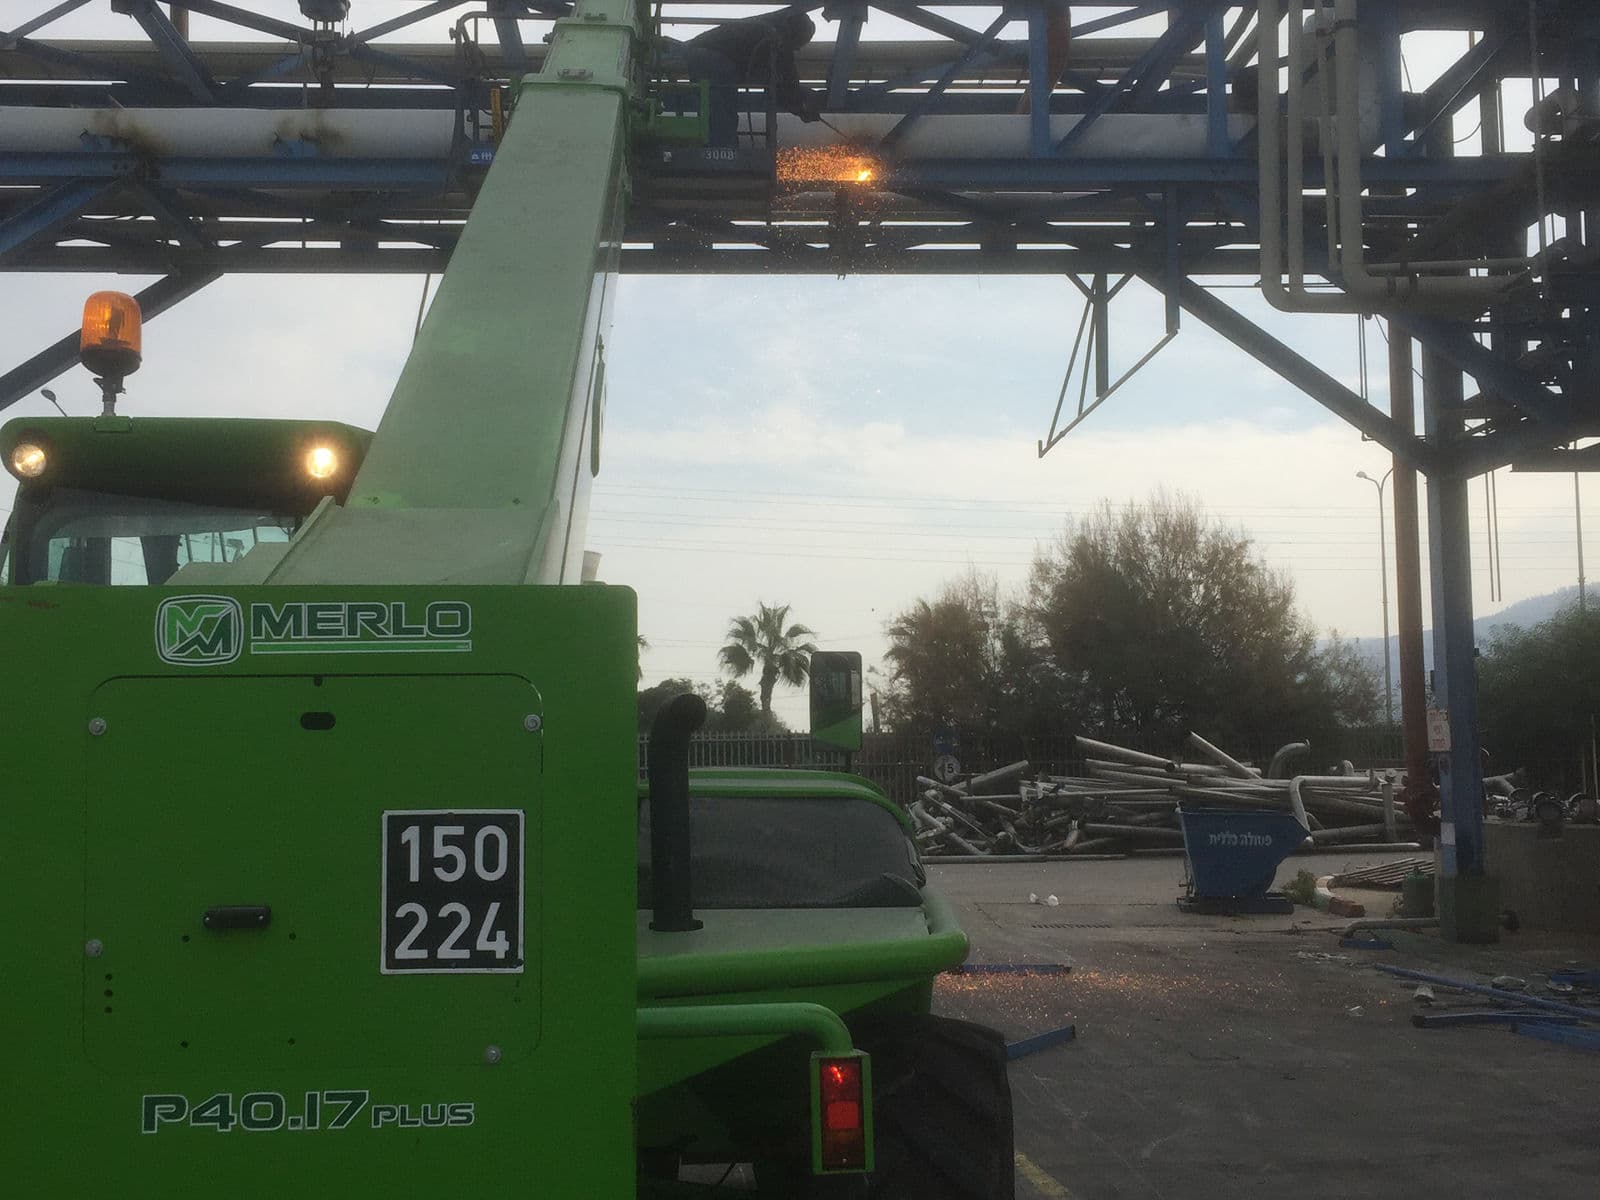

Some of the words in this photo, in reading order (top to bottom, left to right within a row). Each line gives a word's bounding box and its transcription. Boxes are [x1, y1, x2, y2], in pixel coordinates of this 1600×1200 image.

[251, 601, 472, 639] MERLO
[401, 825, 508, 882] 150
[395, 902, 510, 960] 224
[142, 1090, 369, 1133] P40.17
[371, 1103, 475, 1129] PLUS
